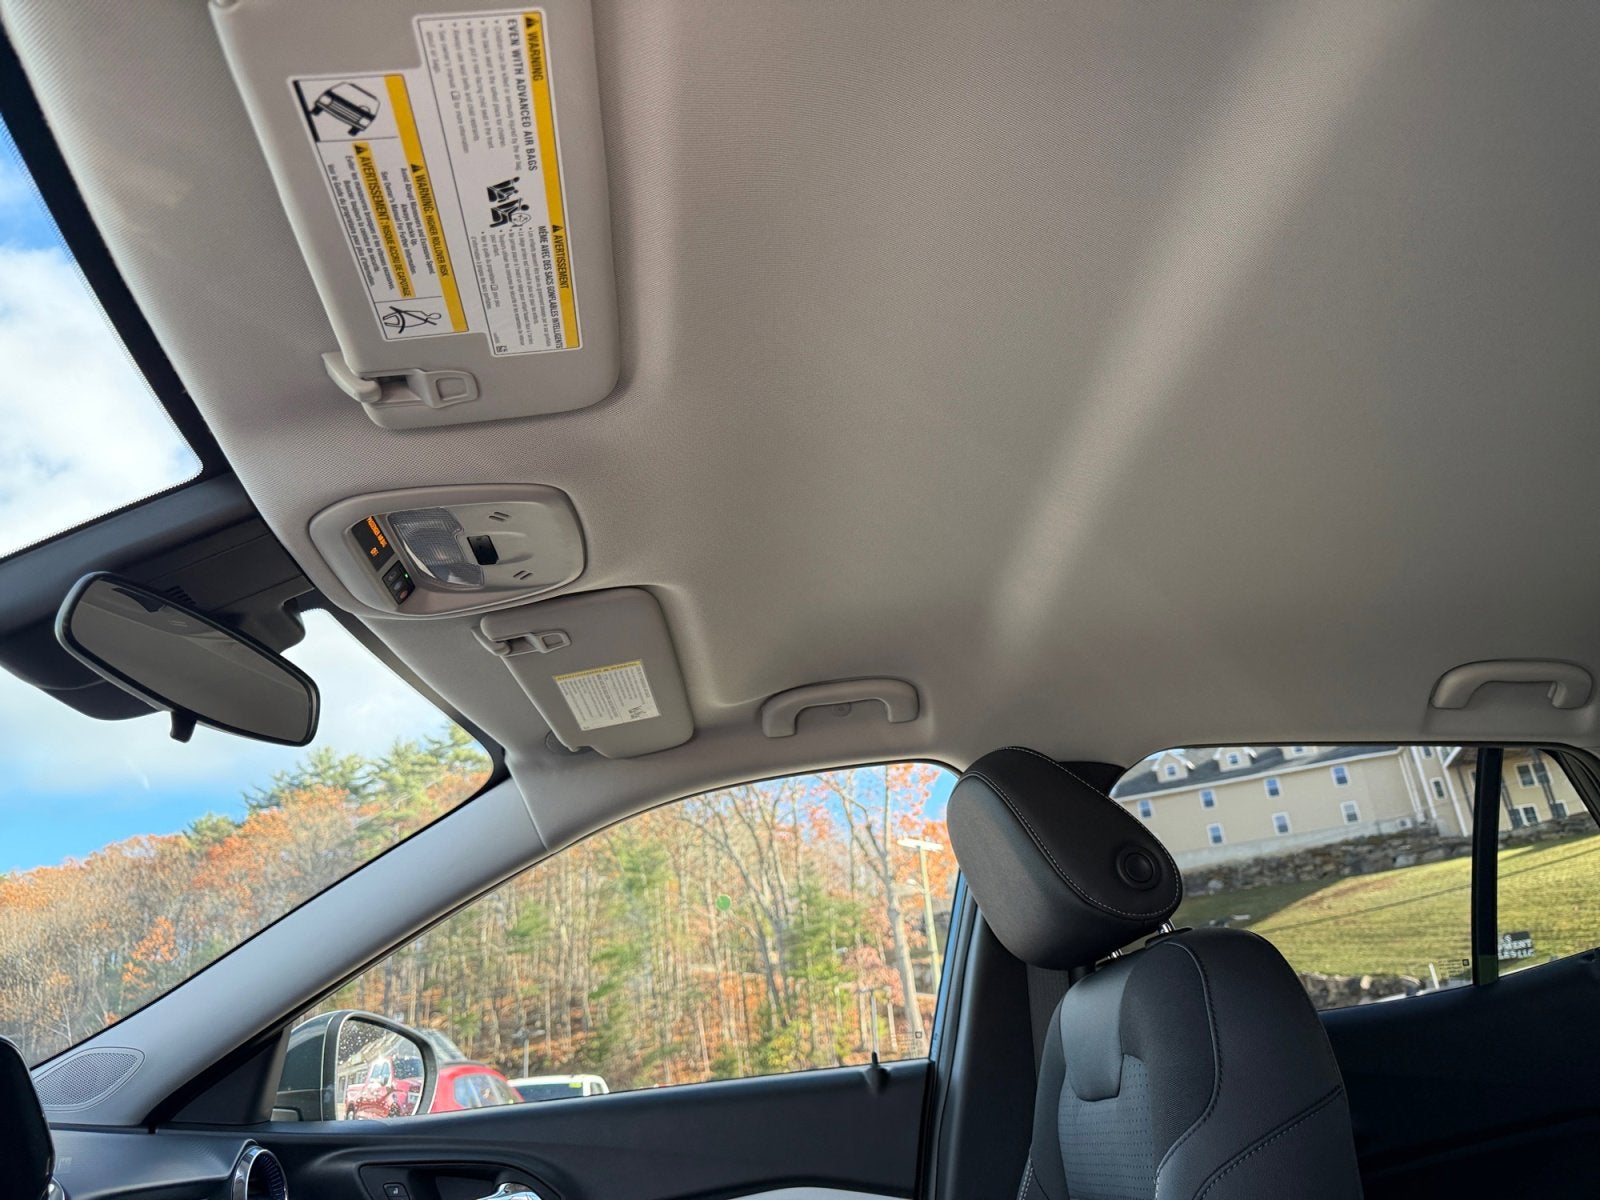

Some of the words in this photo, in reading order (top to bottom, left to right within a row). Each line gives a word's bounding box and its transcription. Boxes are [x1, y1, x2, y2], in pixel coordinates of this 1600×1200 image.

[506, 18, 520, 45] EVEN
[510, 48, 524, 74] WITH
[526, 31, 544, 81] WARNING
[515, 78, 532, 127] ADVANCED
[523, 130, 534, 145] AIR
[525, 148, 538, 171] BAGS
[399, 203, 411, 221] Always
[414, 174, 434, 213] WARNING:
[425, 215, 437, 235] HIGHER
[431, 236, 445, 262] ROLLOVER
[438, 264, 448, 276] RISK
[359, 156, 389, 221] AVERTISSEMENT
[381, 225, 395, 244] RISQUE
[388, 245, 401, 263] ACCRU
[396, 272, 411, 296] CAPOTAGE
[537, 225, 550, 243] MÊME
[540, 244, 550, 258] AVEC
[553, 234, 569, 288] AVERTISSEMENT
[542, 259, 552, 270] DES
[544, 271, 554, 285] SACS
[546, 285, 558, 317] GONFLABLES
